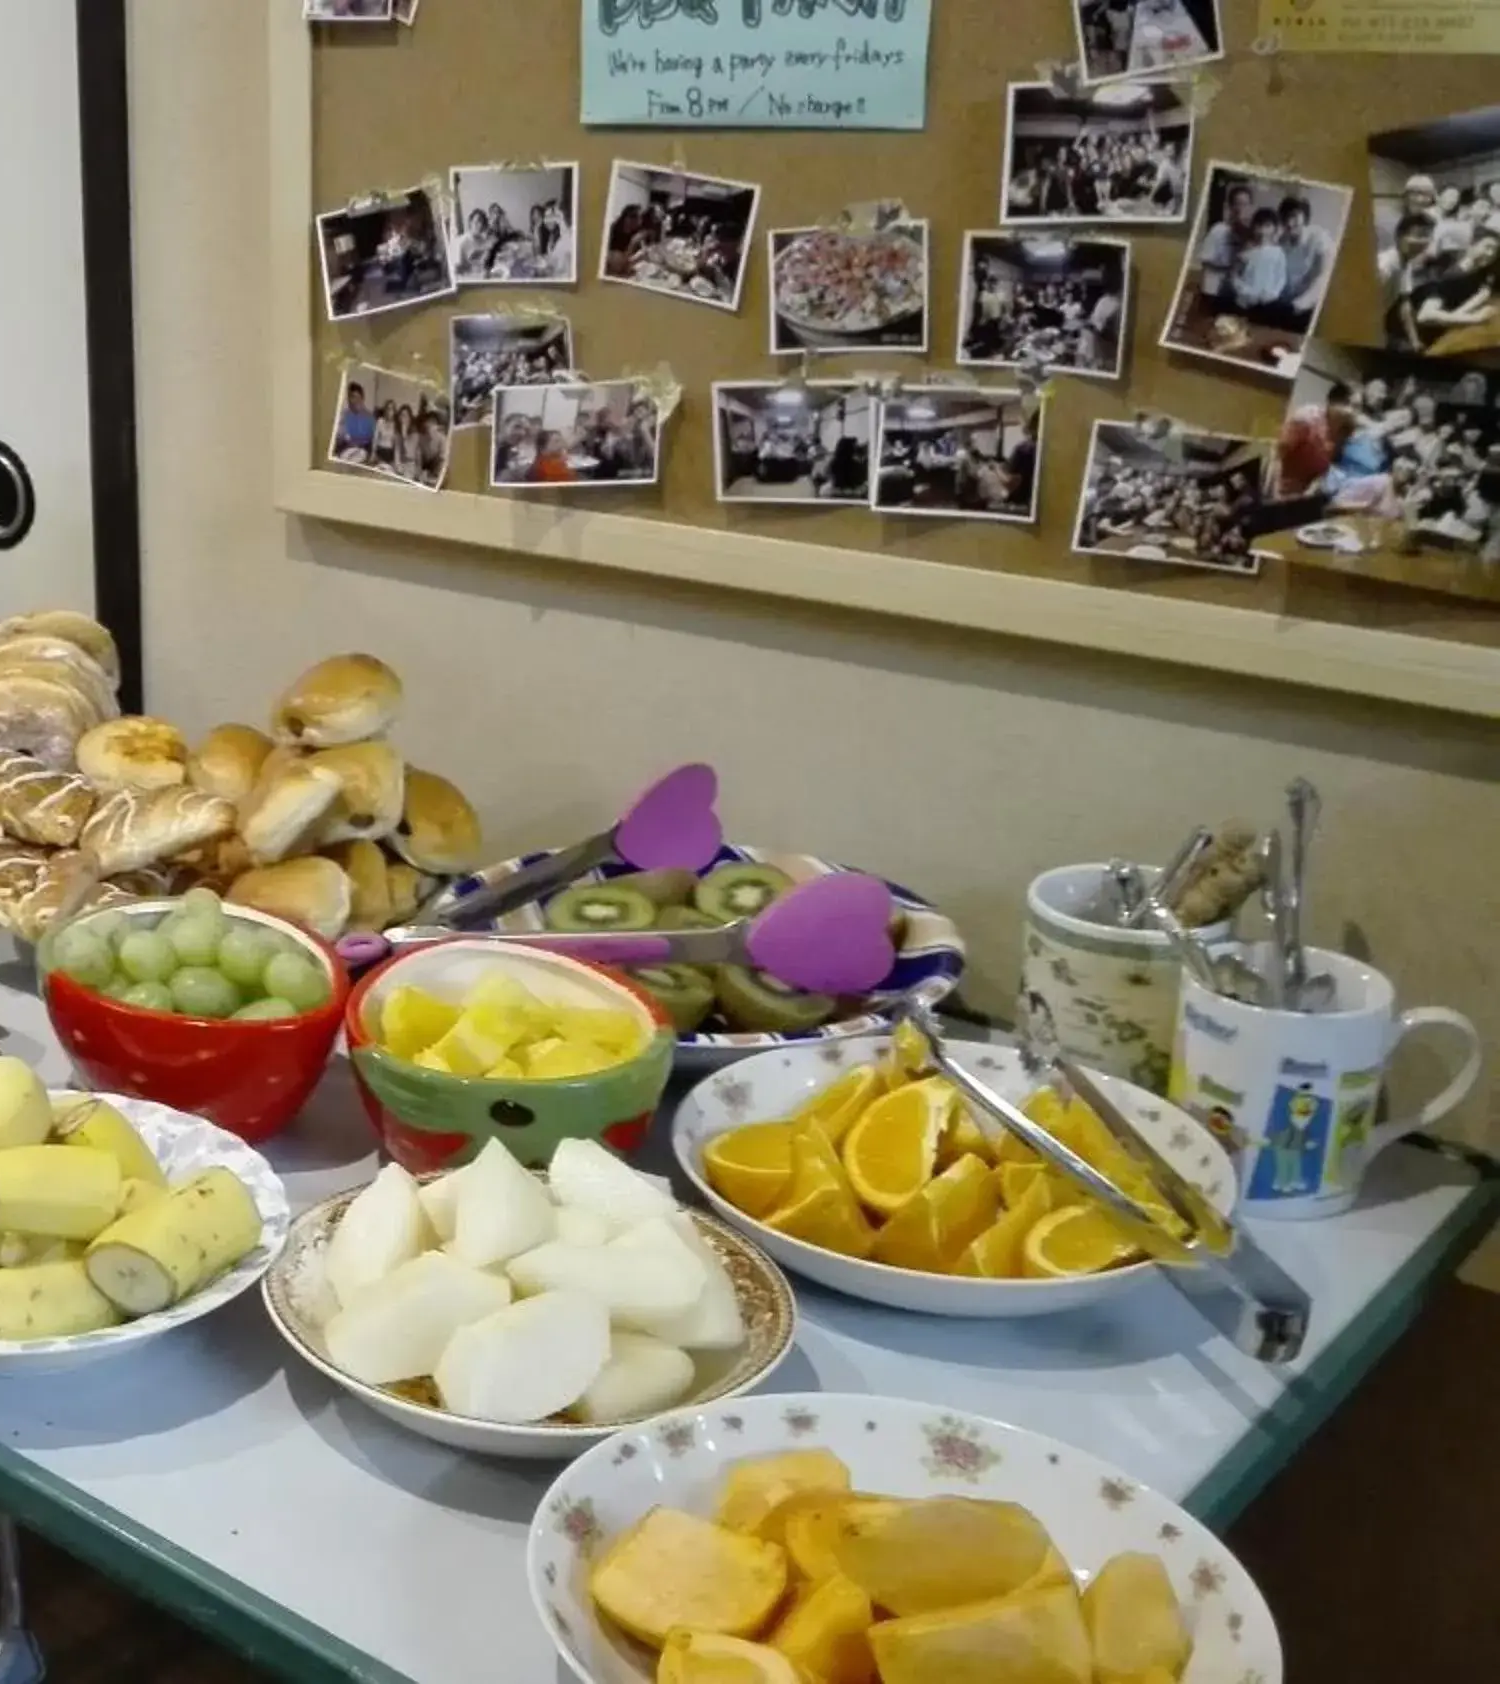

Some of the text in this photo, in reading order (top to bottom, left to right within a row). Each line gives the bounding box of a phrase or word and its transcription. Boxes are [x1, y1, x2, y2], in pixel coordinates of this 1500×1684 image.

[654, 47, 704, 79] having
[712, 55, 725, 75] a
[729, 51, 777, 82] party
[831, 37, 906, 71] fridays
[646, 88, 684, 119] From
[767, 92, 793, 119] No
